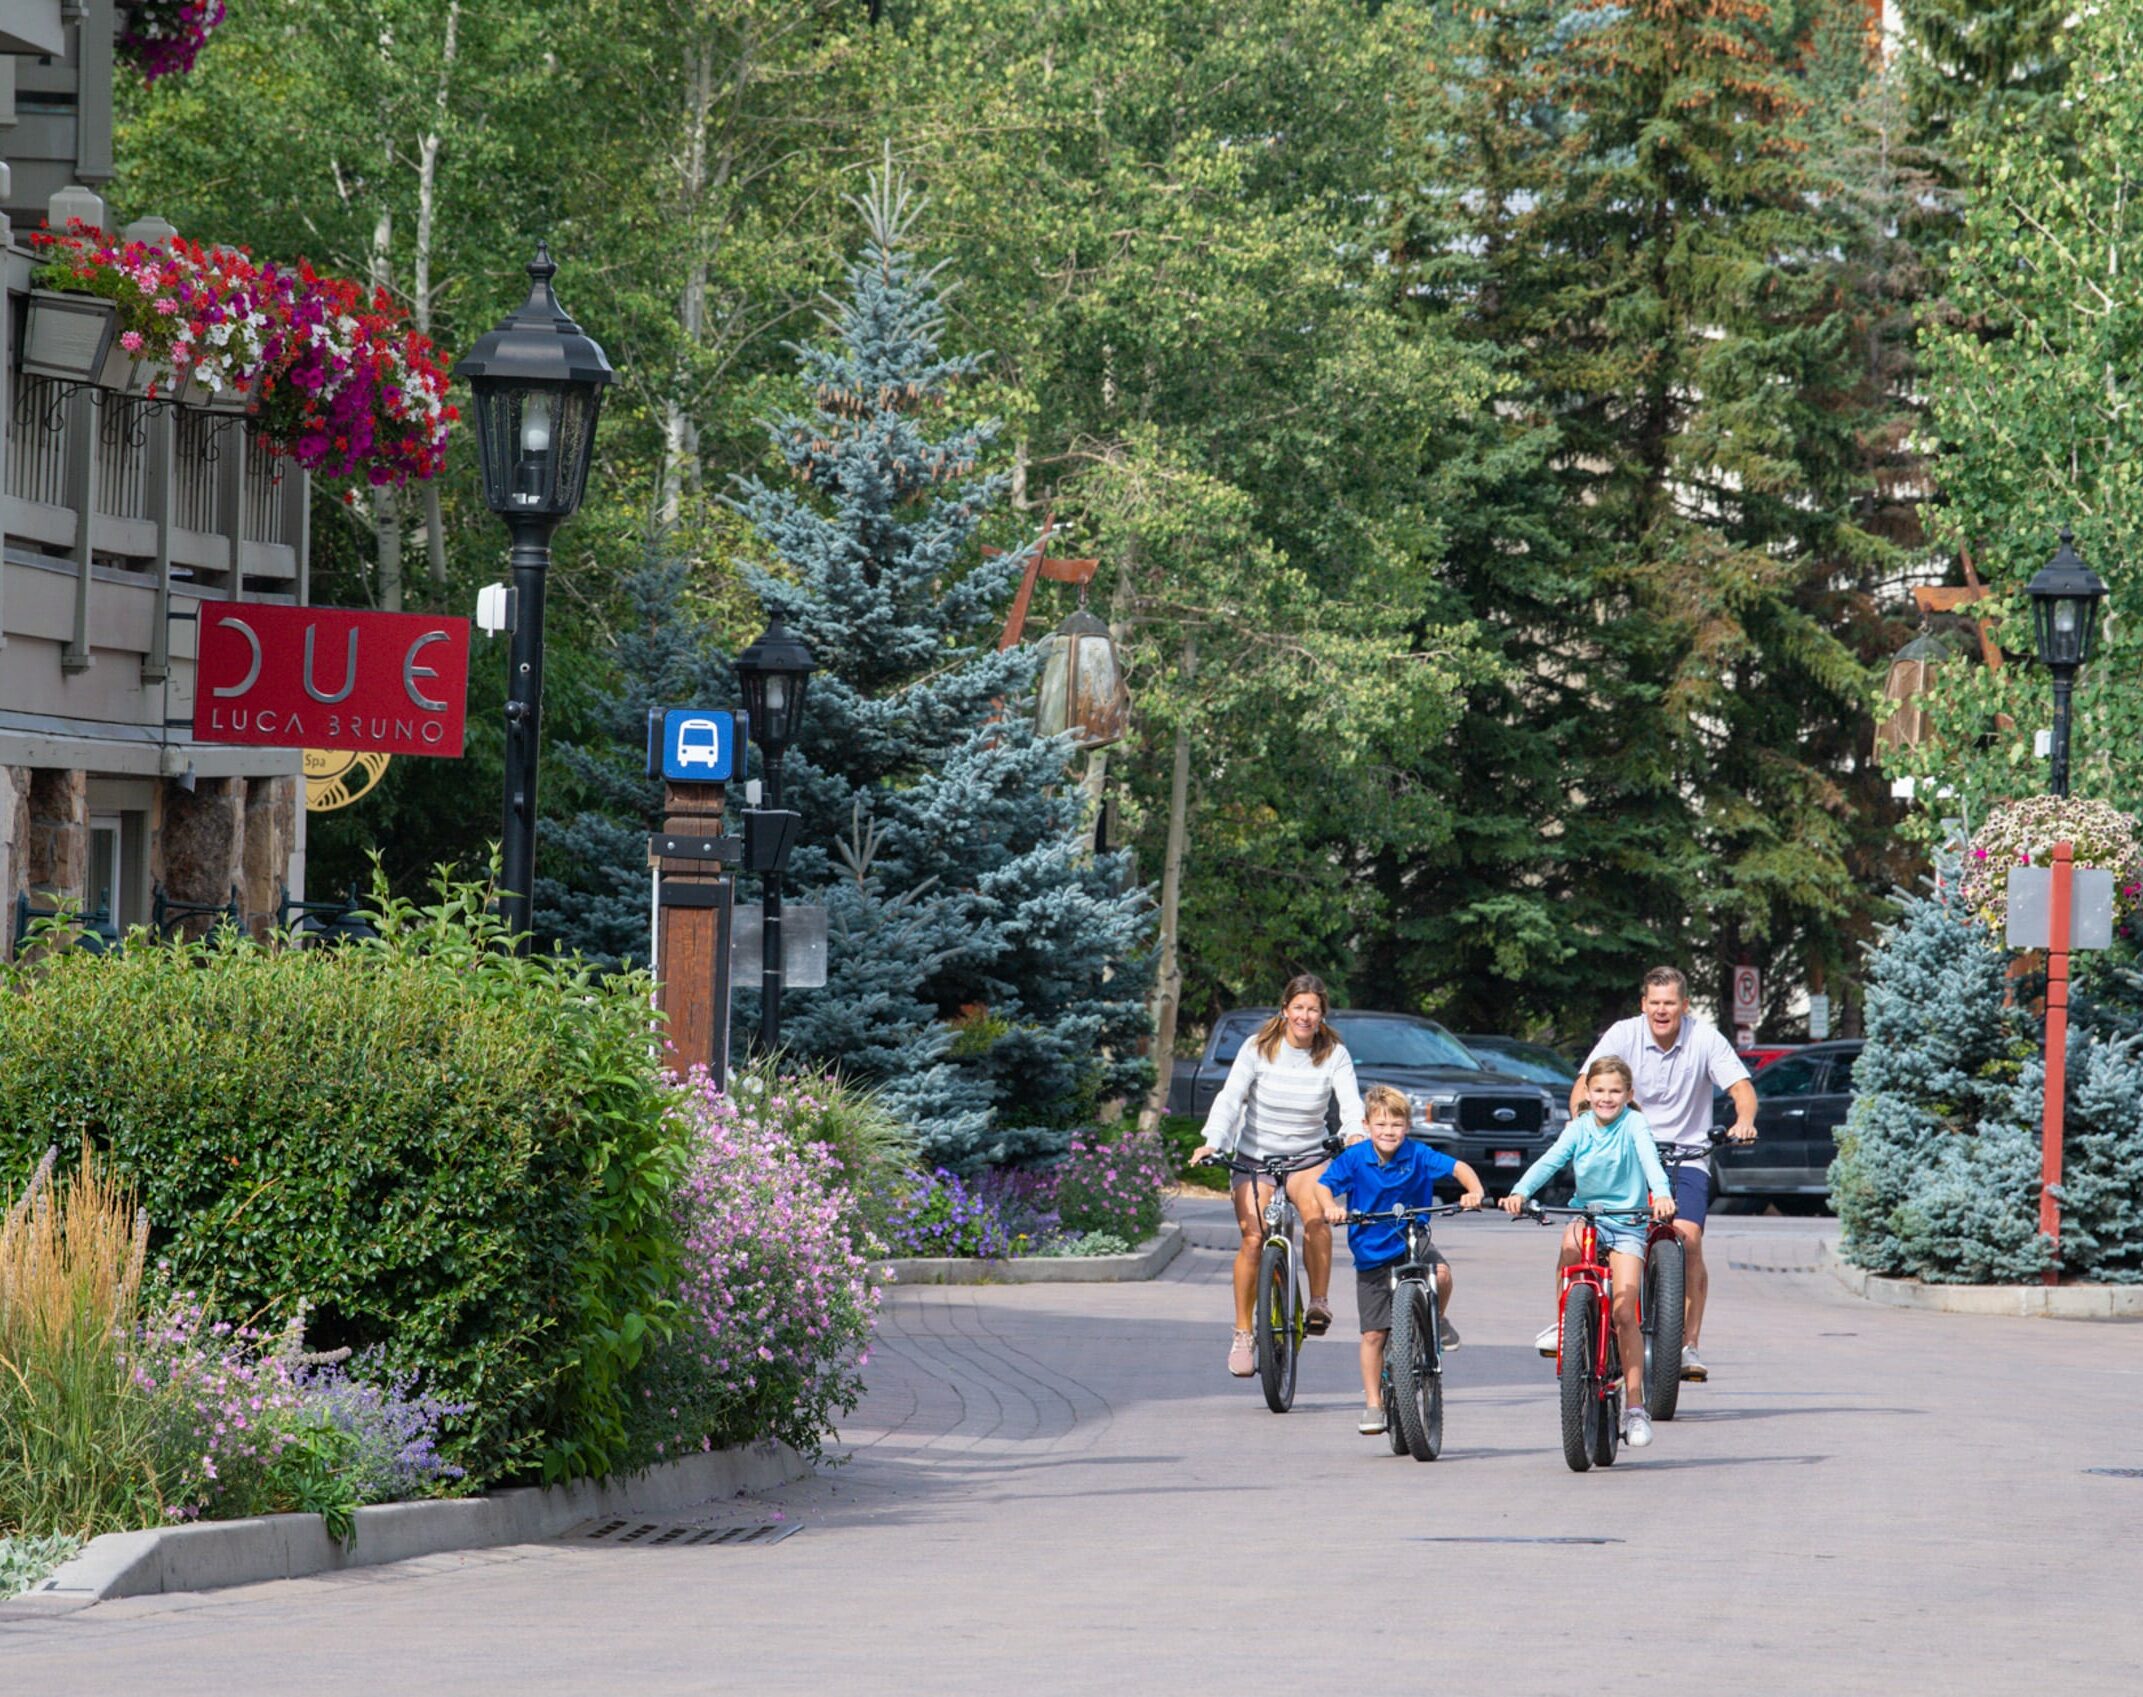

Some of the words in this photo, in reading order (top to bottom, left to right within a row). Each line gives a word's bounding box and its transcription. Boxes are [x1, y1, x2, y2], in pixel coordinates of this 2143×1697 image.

[213, 616, 451, 712] DUE
[211, 708, 304, 734] LUCA
[328, 715, 444, 743] BRUNO
[304, 754, 327, 769] Spa
